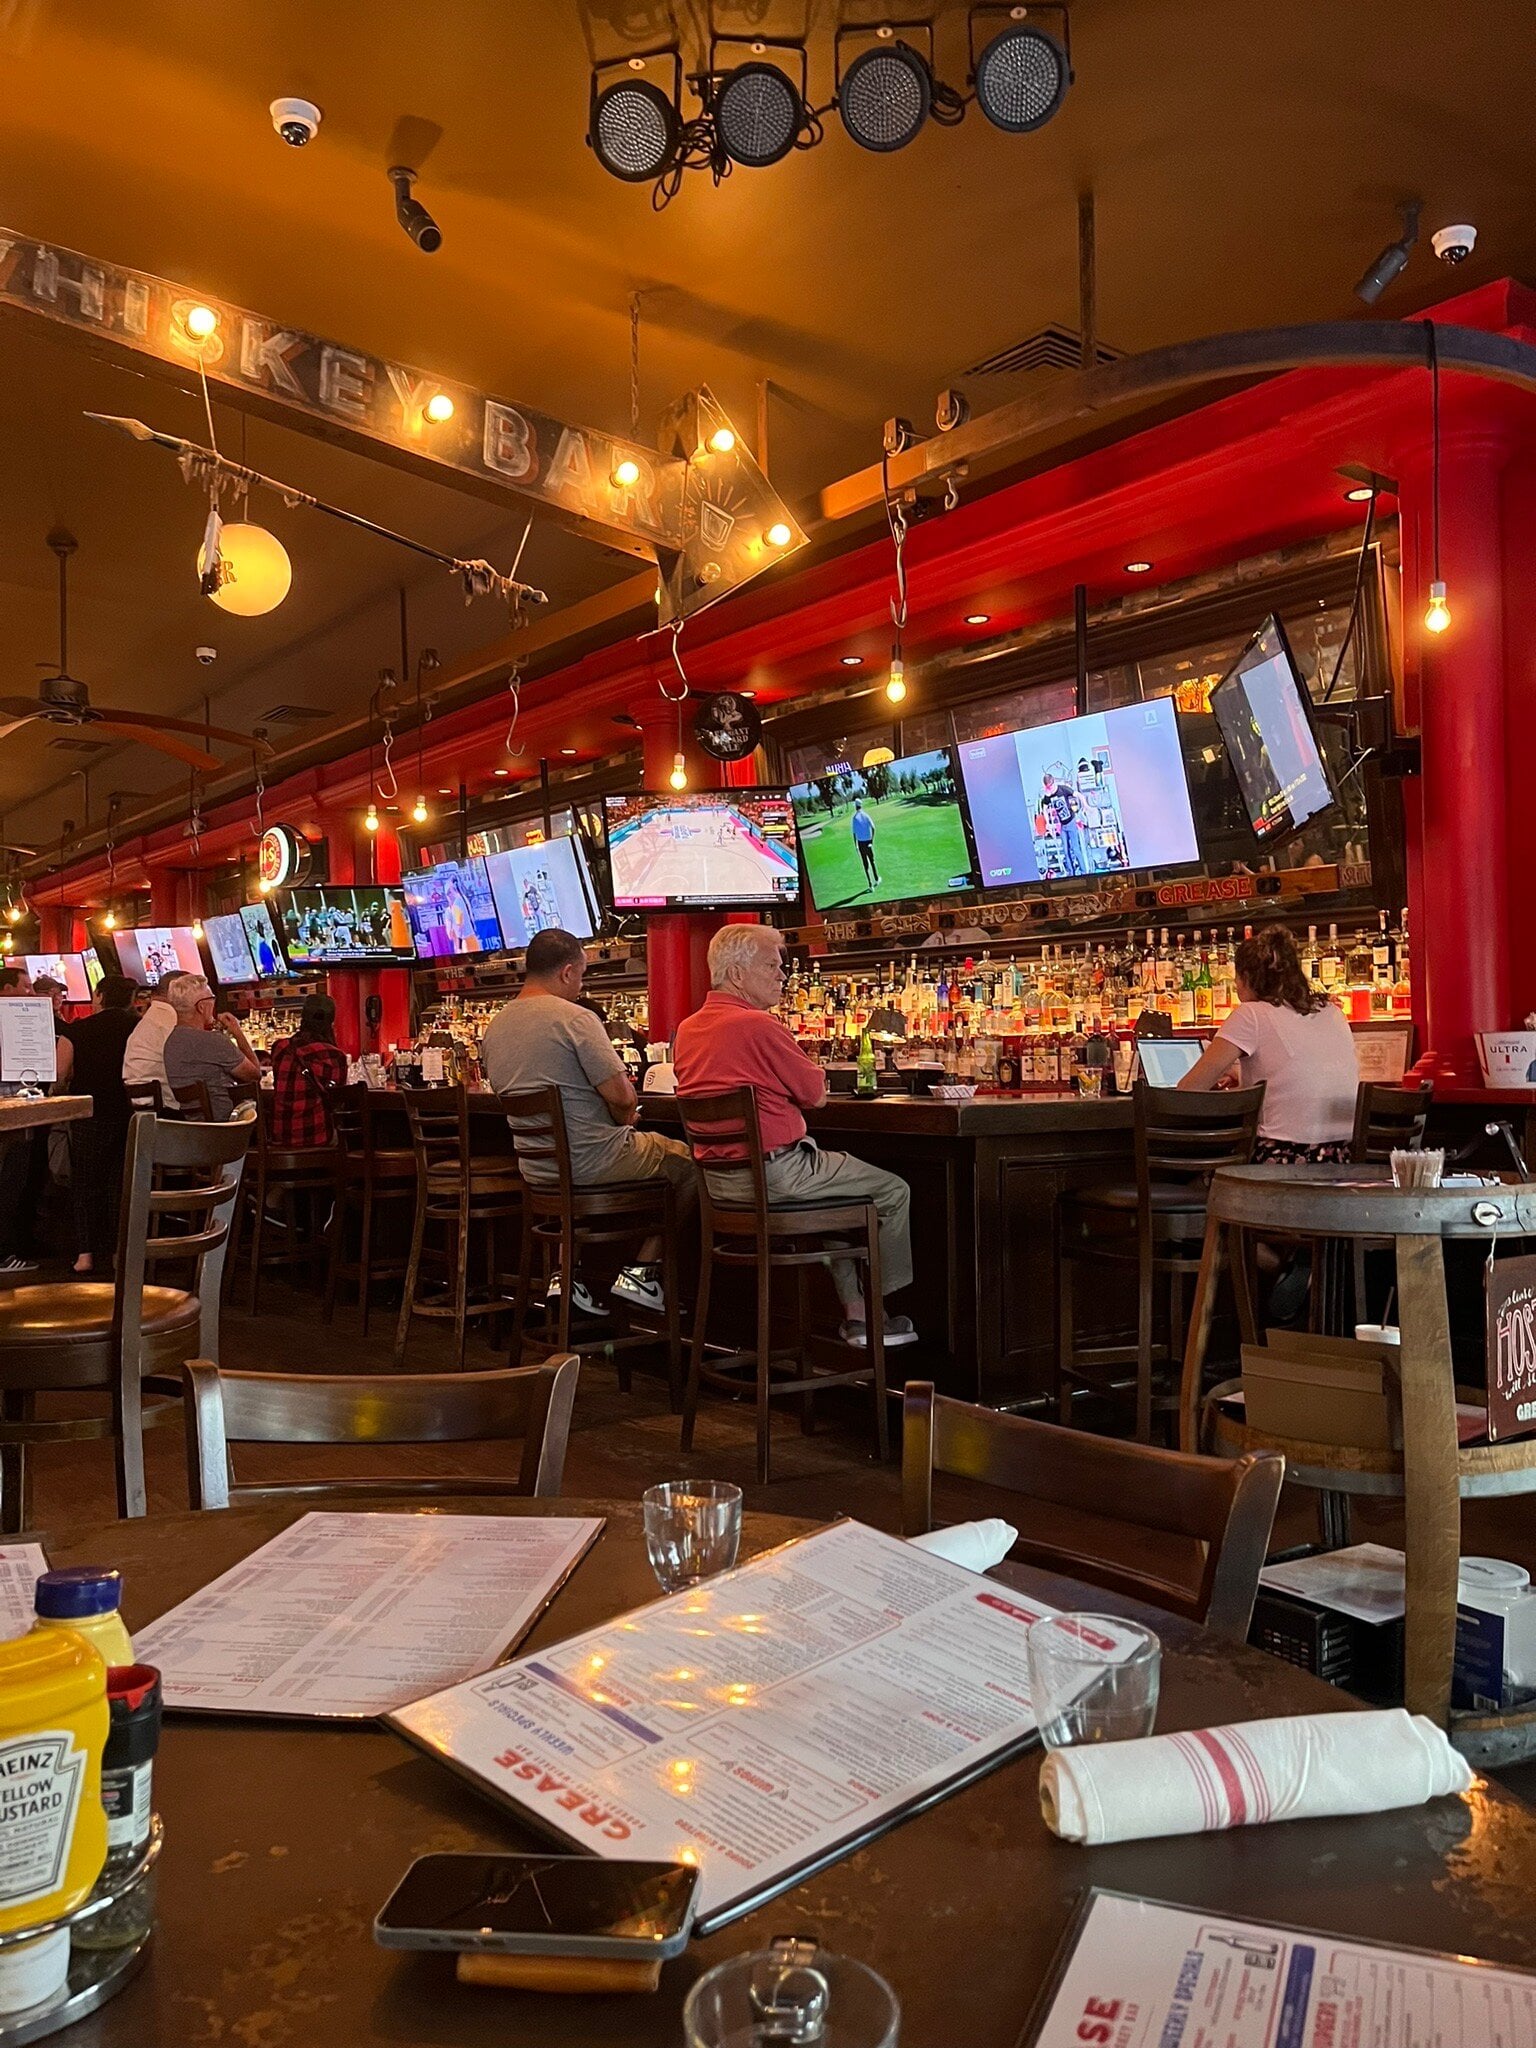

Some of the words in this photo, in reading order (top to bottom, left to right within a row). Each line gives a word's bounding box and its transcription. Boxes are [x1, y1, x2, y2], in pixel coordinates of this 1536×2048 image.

[483, 399, 665, 530] BAR
[1158, 877, 1251, 905] GREASE
[1490, 1045, 1528, 1054] ULTRA
[487, 1699, 536, 1730] SPECIALS
[530, 1727, 575, 1756] WEEKLY
[0, 1777, 54, 1803] ELLOW
[733, 1766, 775, 1793] WINGS
[493, 1748, 631, 1840] GREASE
